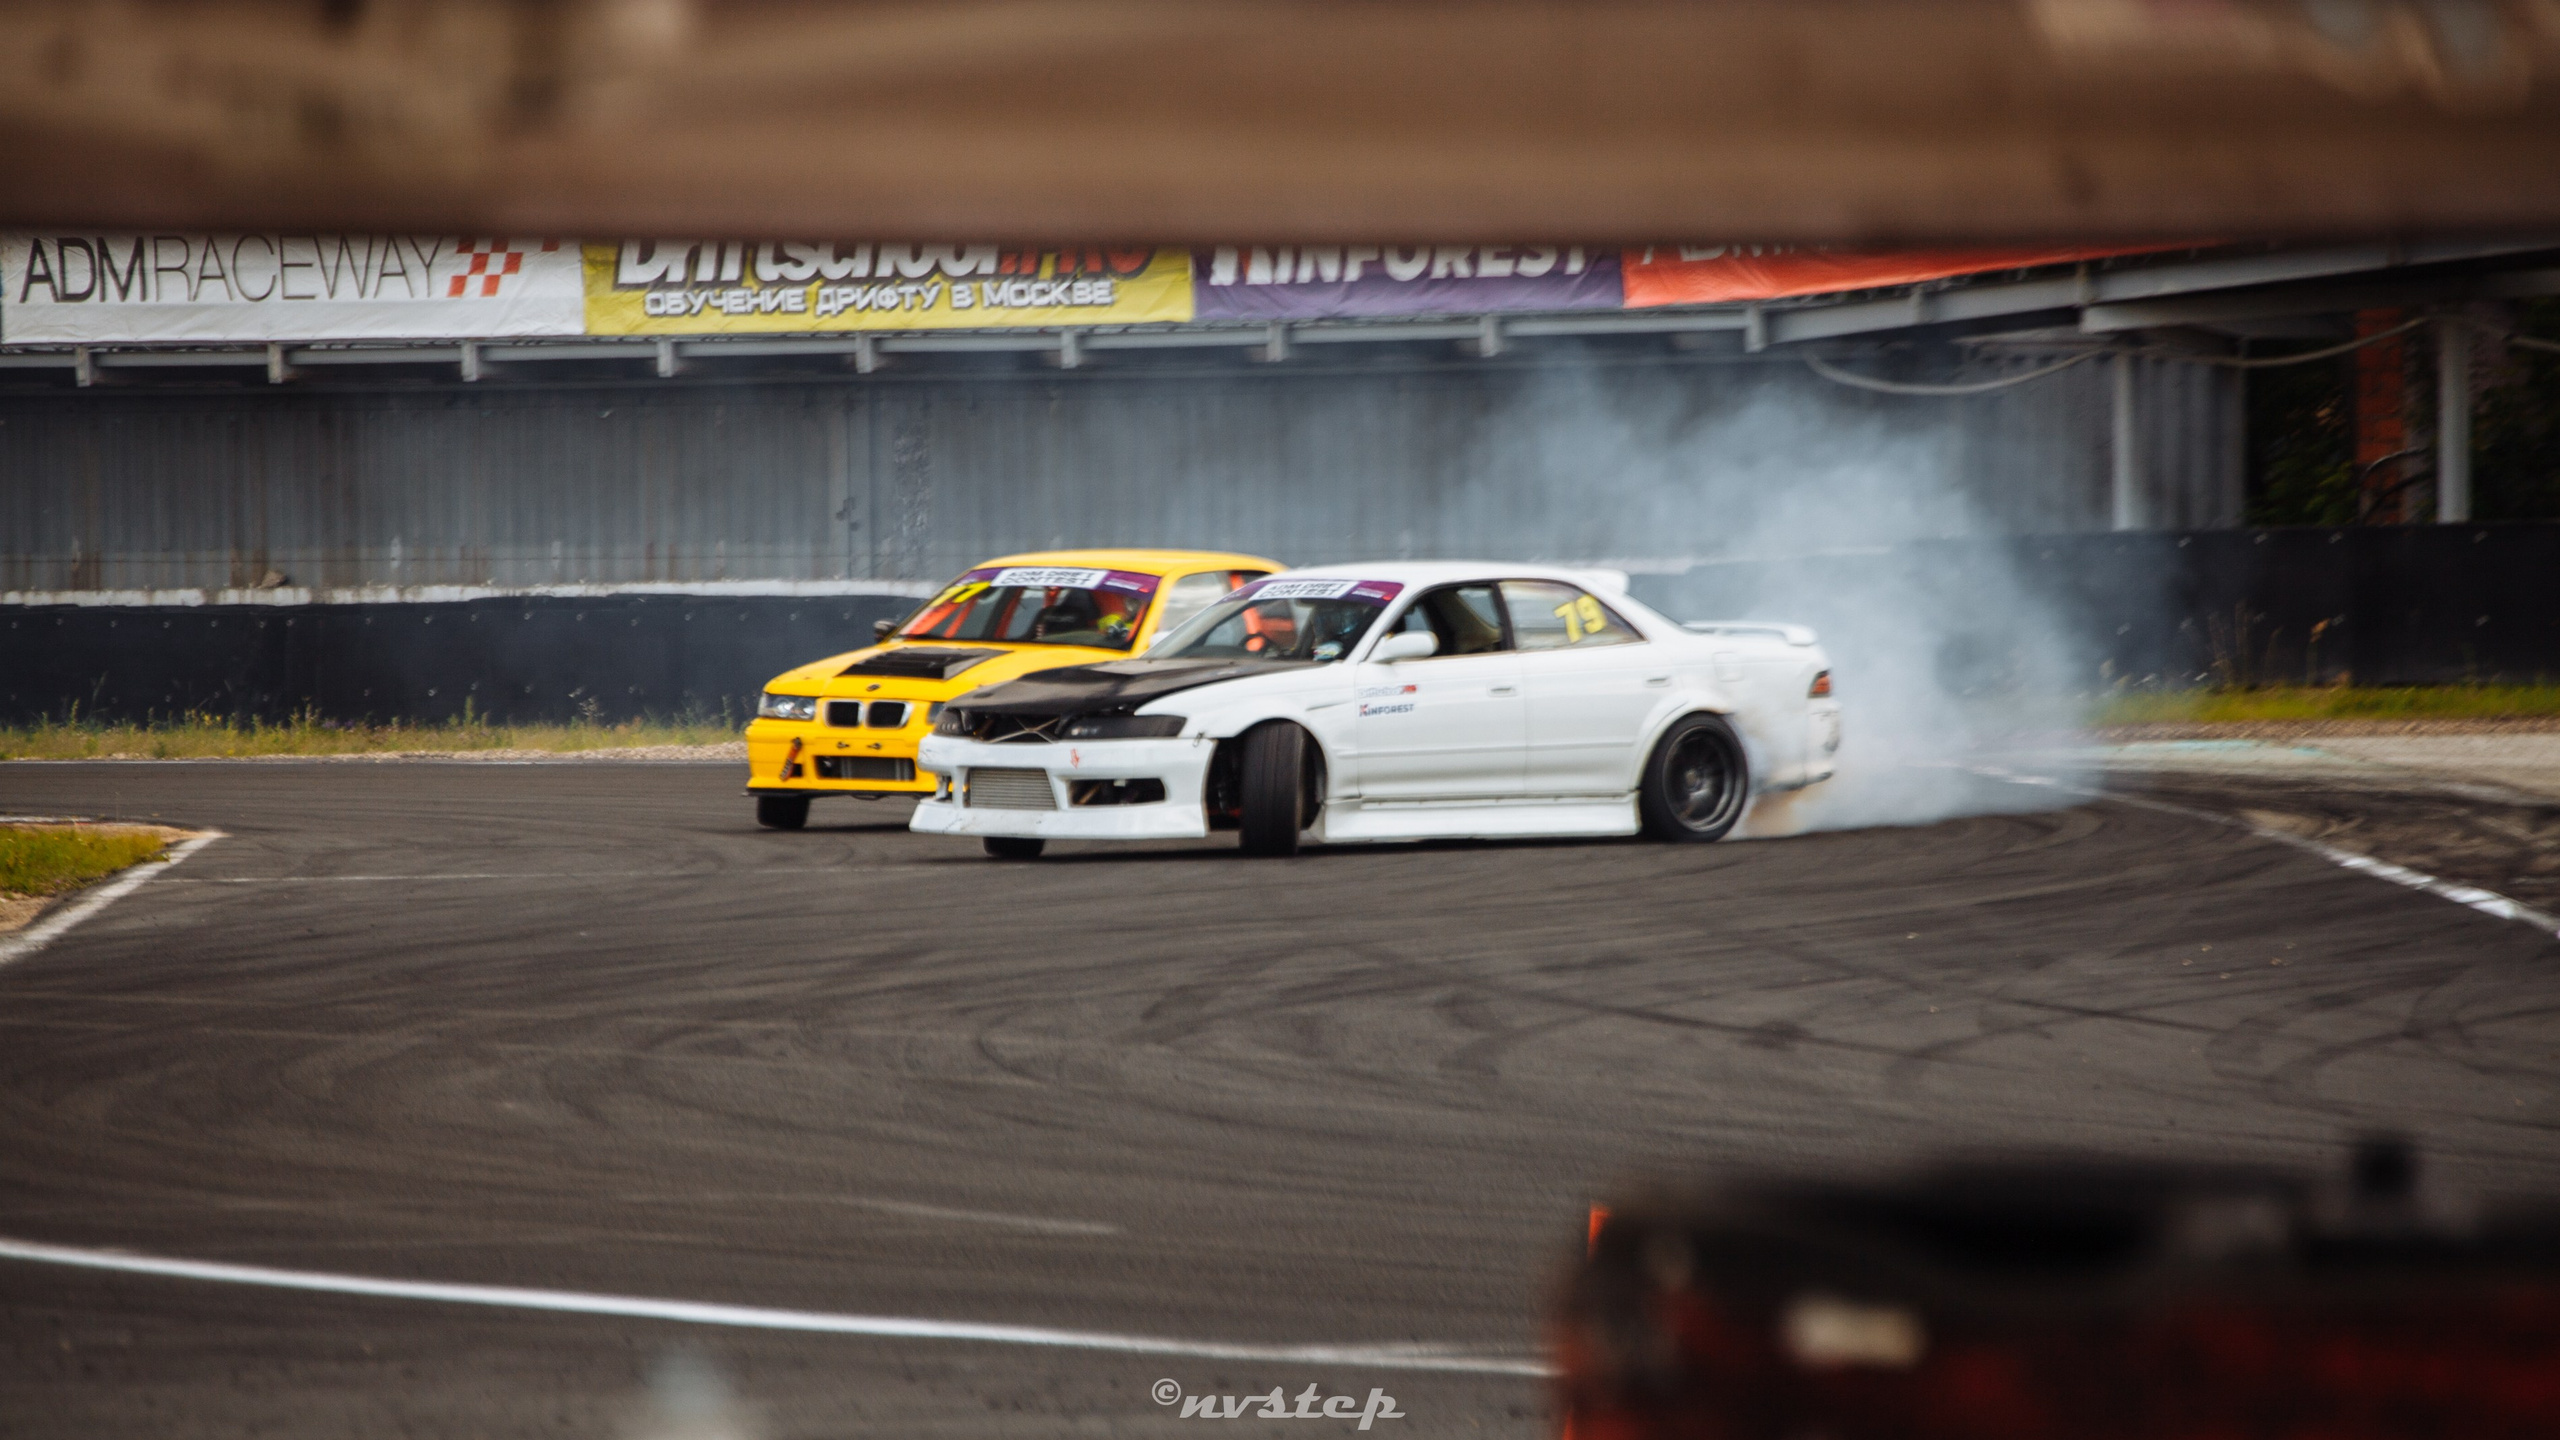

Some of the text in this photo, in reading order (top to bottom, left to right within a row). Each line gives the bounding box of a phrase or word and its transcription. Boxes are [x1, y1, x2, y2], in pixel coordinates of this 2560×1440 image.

[645, 287, 806, 316] ОБУЧЕНИЕ
[816, 282, 941, 317] ДРИФТУ
[951, 283, 974, 308] В
[1001, 577, 1091, 585] CONTEST
[1259, 589, 1338, 598] CONTEST
[1554, 594, 1607, 643] 79
[1359, 703, 1414, 717] KINFOREST
